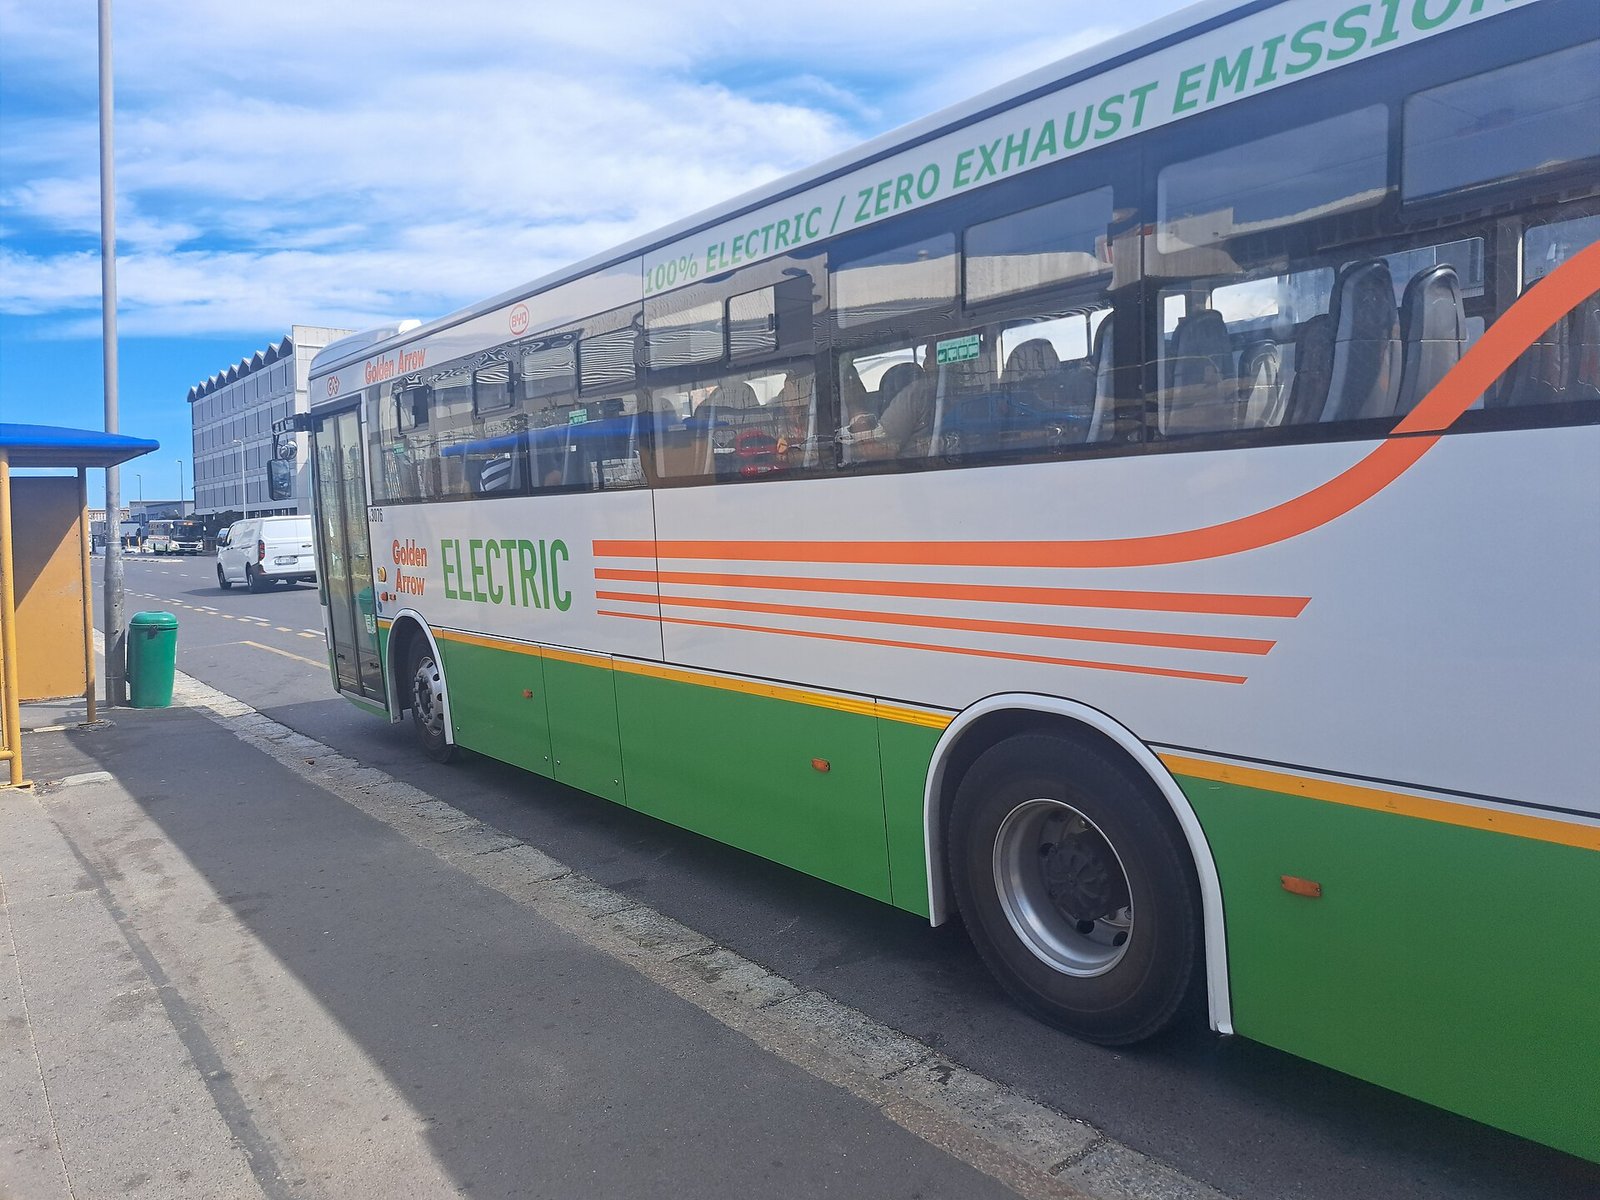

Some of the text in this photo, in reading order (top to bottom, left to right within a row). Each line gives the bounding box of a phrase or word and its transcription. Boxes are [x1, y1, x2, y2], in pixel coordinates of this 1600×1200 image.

[644, 0, 1526, 294] 100% ELECTRIC / ZERO EXHAUST EMISSIO
[364, 348, 426, 384] Golden Arrow
[392, 539, 428, 567] Golden
[395, 568, 426, 596] Arrow
[440, 538, 572, 612] ELECTRIC
